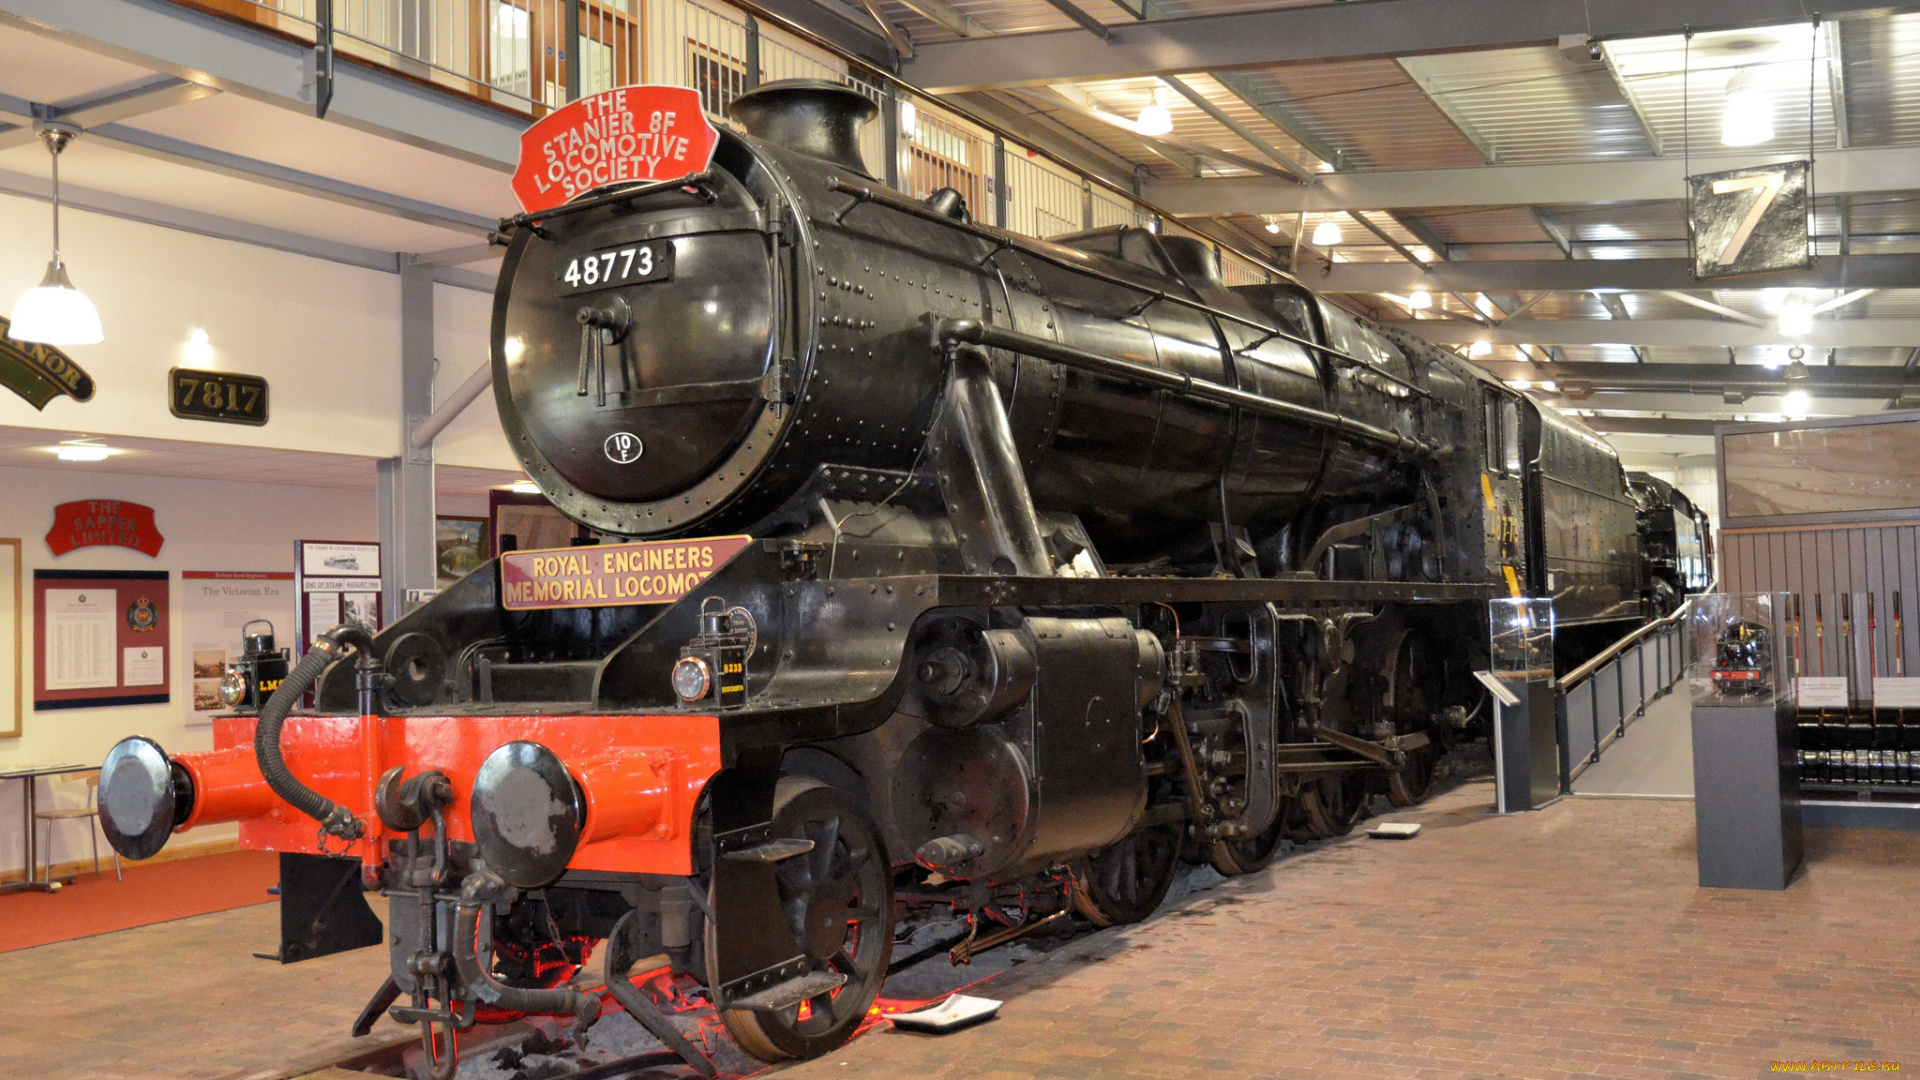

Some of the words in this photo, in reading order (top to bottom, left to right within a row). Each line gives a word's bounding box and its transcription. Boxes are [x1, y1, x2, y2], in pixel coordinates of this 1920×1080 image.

[582, 91, 627, 119] THE
[543, 112, 635, 164] STANIER
[650, 111, 676, 134] 8F
[534, 134, 689, 194] LOCOMOTIVE
[562, 156, 661, 198] SOCIETY
[1712, 169, 1787, 266] 7
[564, 246, 653, 288] 48773
[179, 377, 261, 413] 7817
[615, 435, 631, 451] 10
[621, 449, 628, 462] F
[89, 501, 120, 514] THE
[74, 516, 137, 532] SAPPER
[71, 530, 140, 547] LIMITED
[533, 556, 593, 578] ROYAL
[603, 546, 714, 574] ENGINEERS
[202, 586, 220, 596] The
[222, 586, 262, 596] Victorian
[264, 586, 280, 596] Era
[507, 579, 608, 602] MEMORIAL
